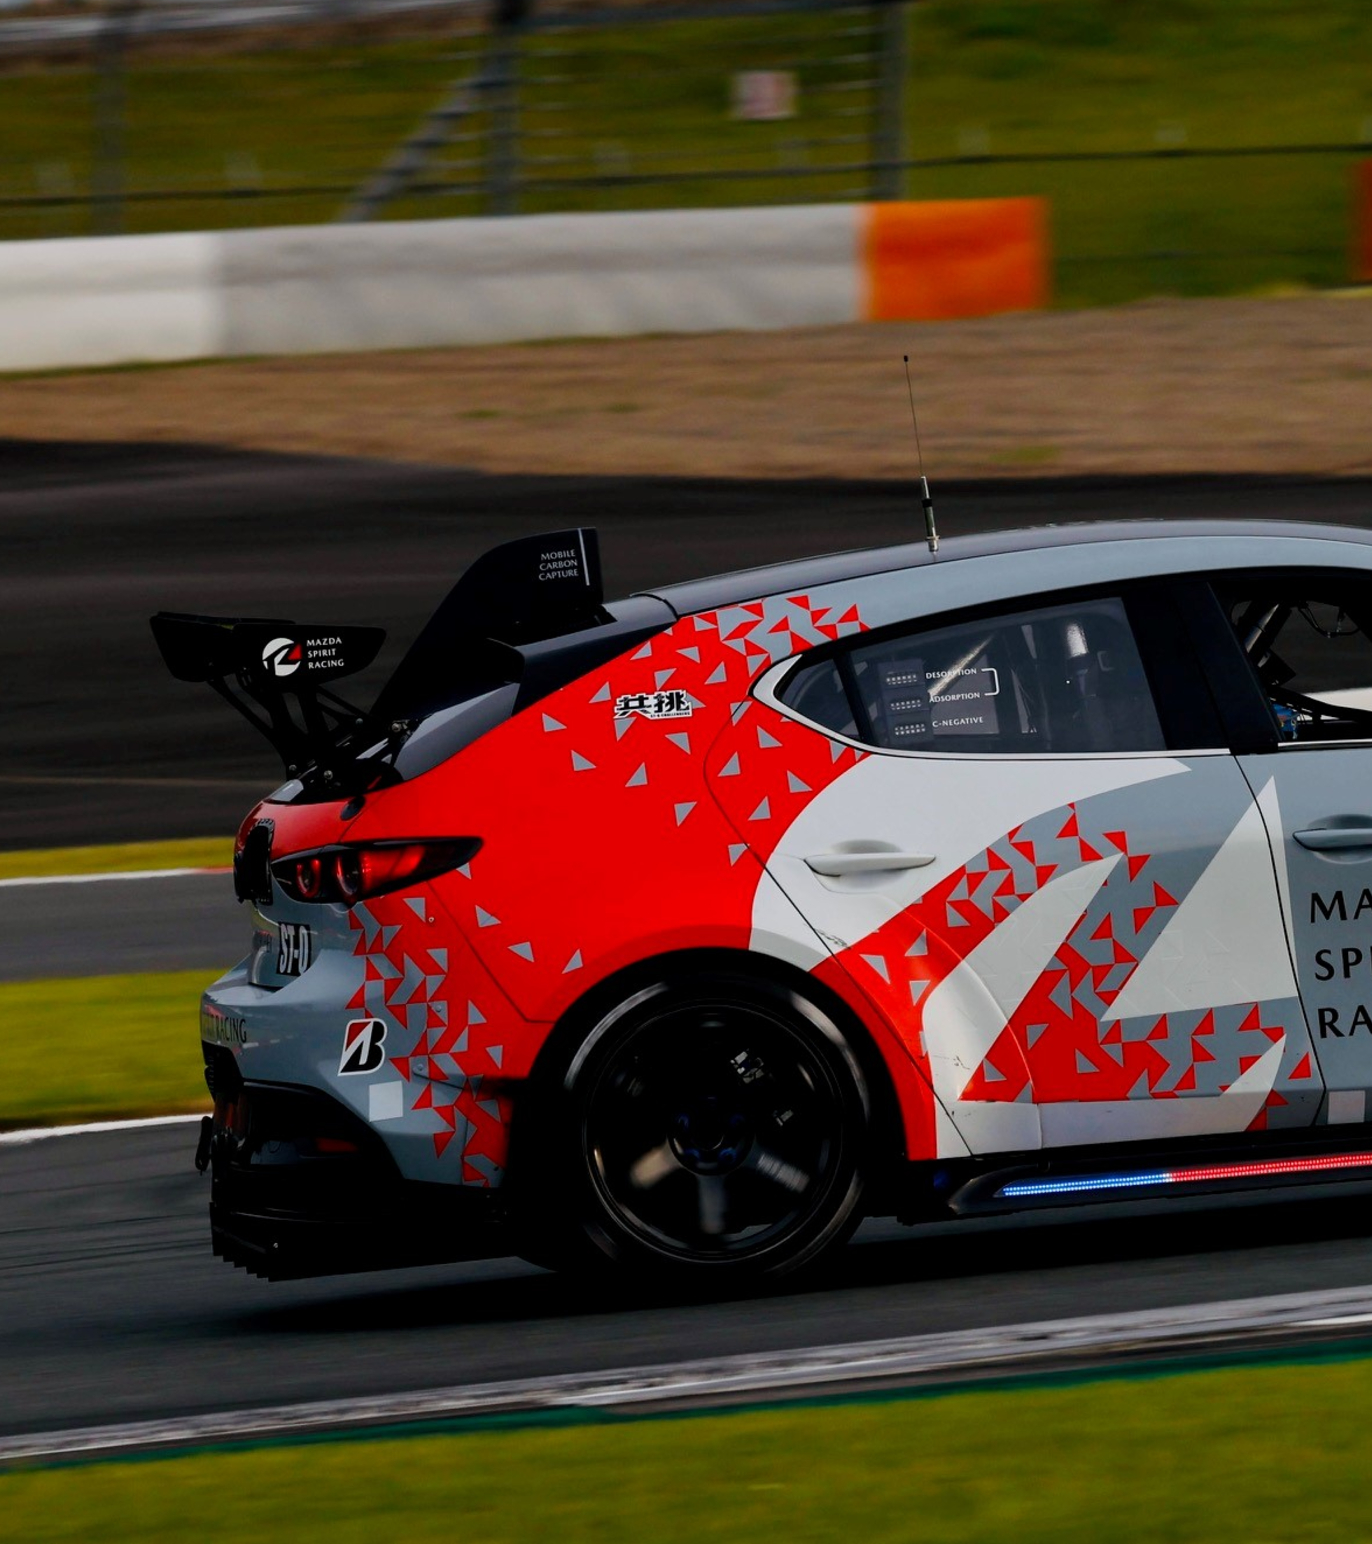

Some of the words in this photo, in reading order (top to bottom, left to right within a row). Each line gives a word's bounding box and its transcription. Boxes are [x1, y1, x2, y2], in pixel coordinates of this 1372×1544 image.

[540, 549, 576, 561] MOBILE
[539, 559, 578, 571] CARBON
[538, 569, 579, 581] CAPTURE
[305, 636, 343, 647] MAZDA
[307, 647, 337, 658] SPIRIT
[307, 658, 345, 670] RACING
[929, 692, 981, 703] ADSORPTION
[932, 716, 984, 728] C-NEGATIVE
